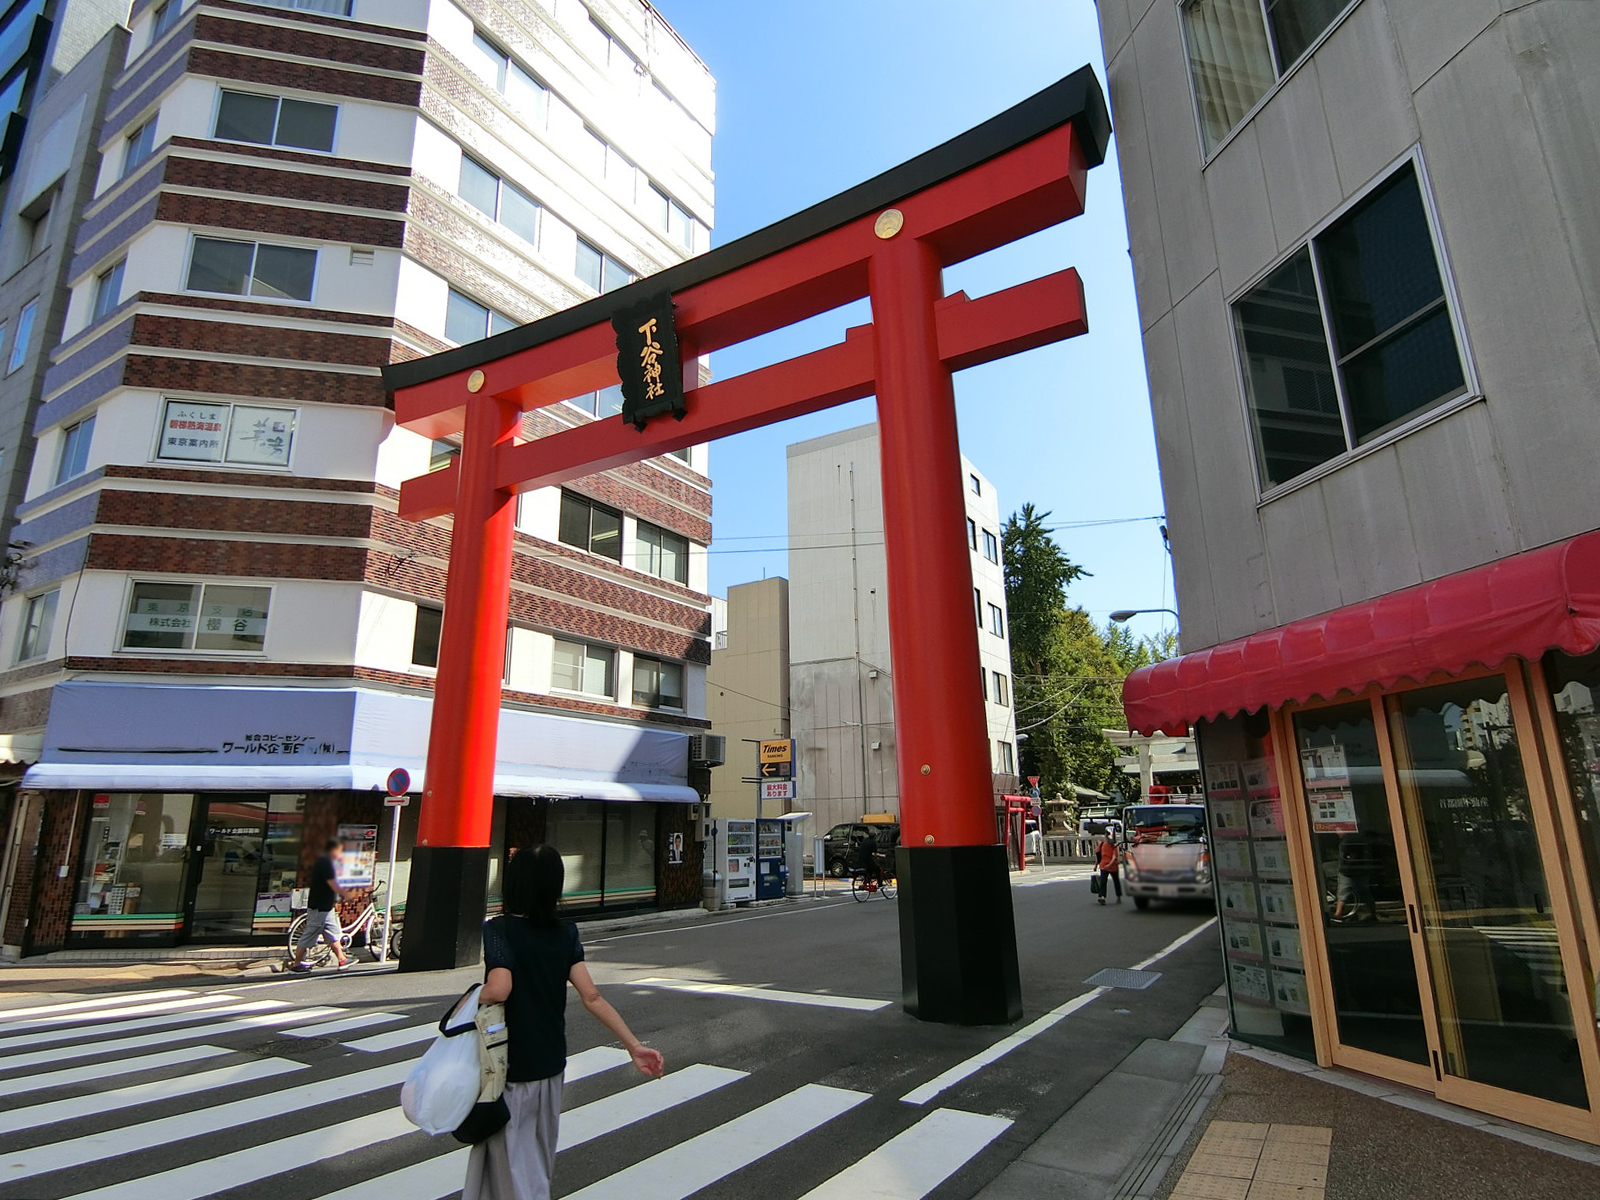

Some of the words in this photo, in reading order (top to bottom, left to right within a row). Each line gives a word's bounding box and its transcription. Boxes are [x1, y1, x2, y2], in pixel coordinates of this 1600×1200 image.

[638, 318, 665, 400] 下谷神社
[177, 411, 216, 420] ふくしま
[167, 437, 219, 449] 東京案内所
[149, 617, 191, 628] 株式会社
[763, 745, 787, 753] Times
